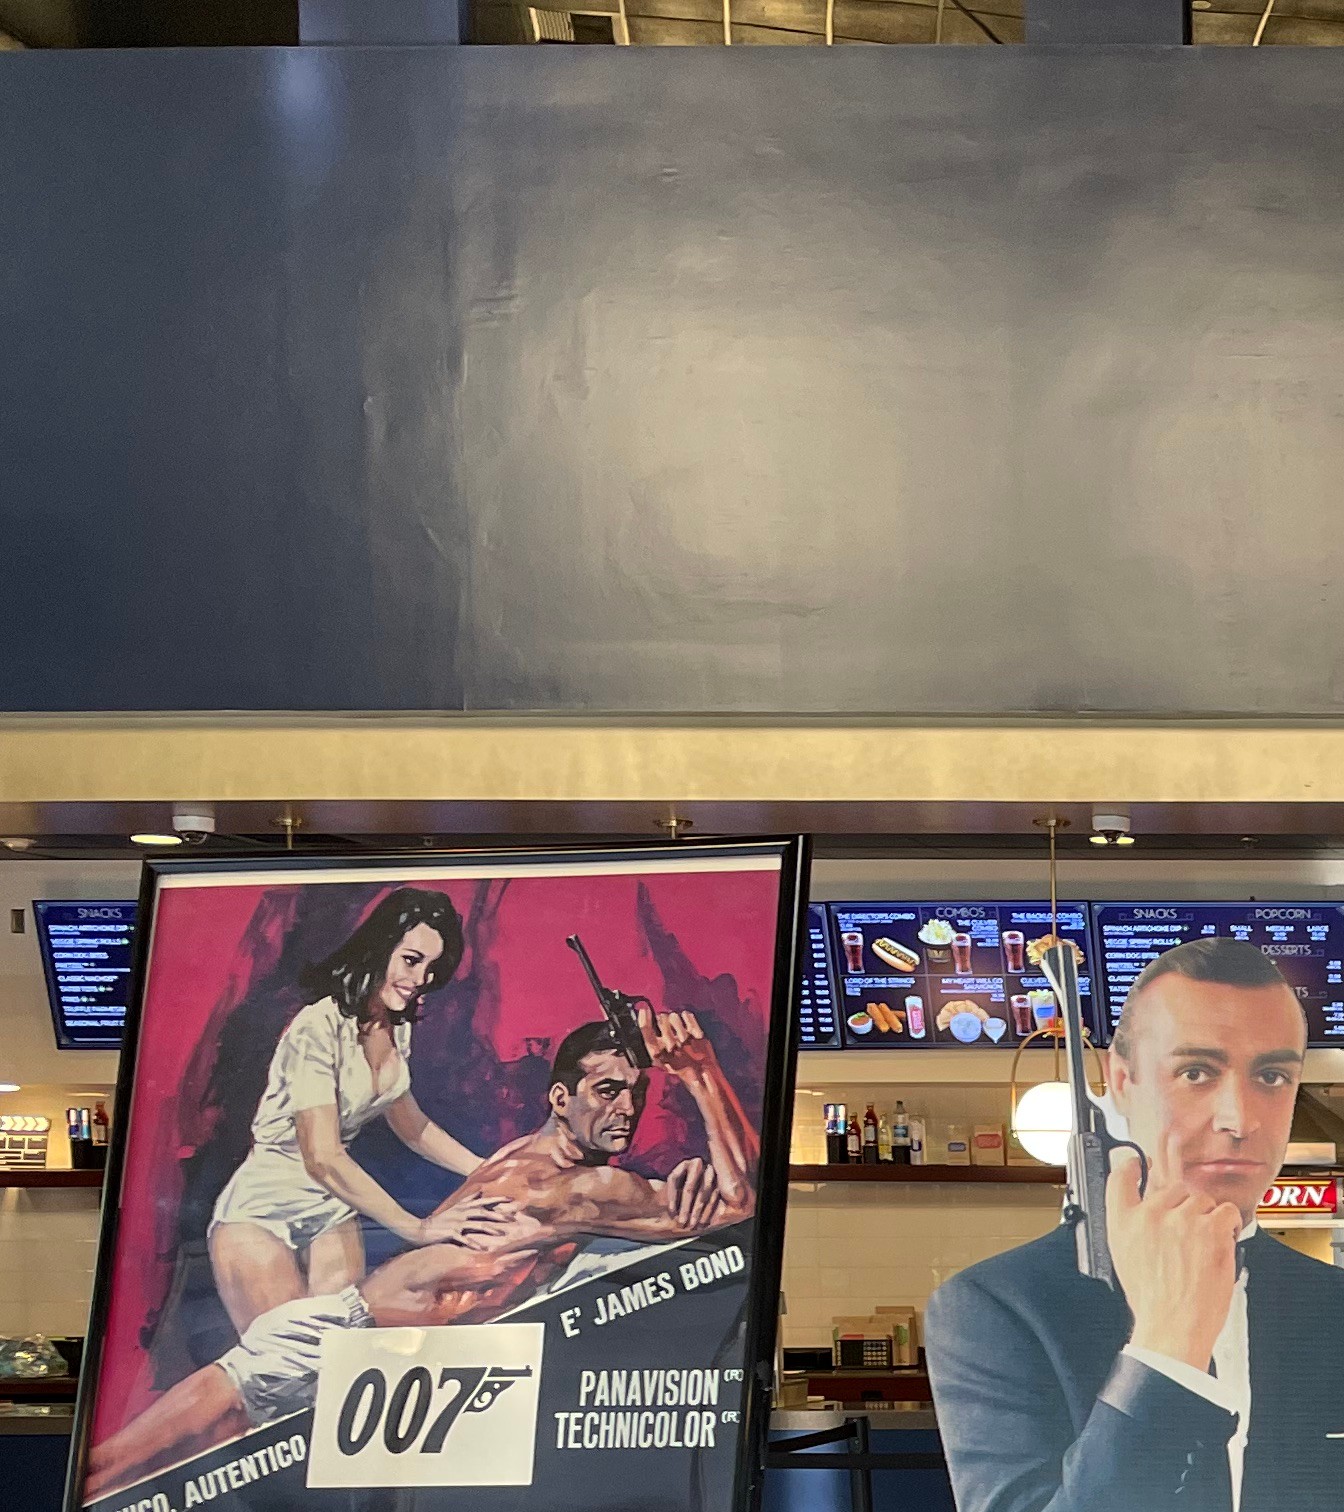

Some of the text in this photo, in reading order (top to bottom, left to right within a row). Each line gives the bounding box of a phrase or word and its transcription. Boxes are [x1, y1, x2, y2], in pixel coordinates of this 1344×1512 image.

[77, 908, 122, 919] SNACKS
[935, 907, 986, 919] COMBOS
[1133, 909, 1177, 919] SNACKS
[1255, 909, 1311, 920] POPCORN
[594, 1273, 675, 1325] JAMES
[679, 1245, 745, 1291] BOND
[579, 1369, 720, 1407] PANAVISION
[337, 1364, 524, 1456] 007
[554, 1411, 716, 1449] TECHNICOLOR
[185, 1435, 307, 1508] AUTENTICO
